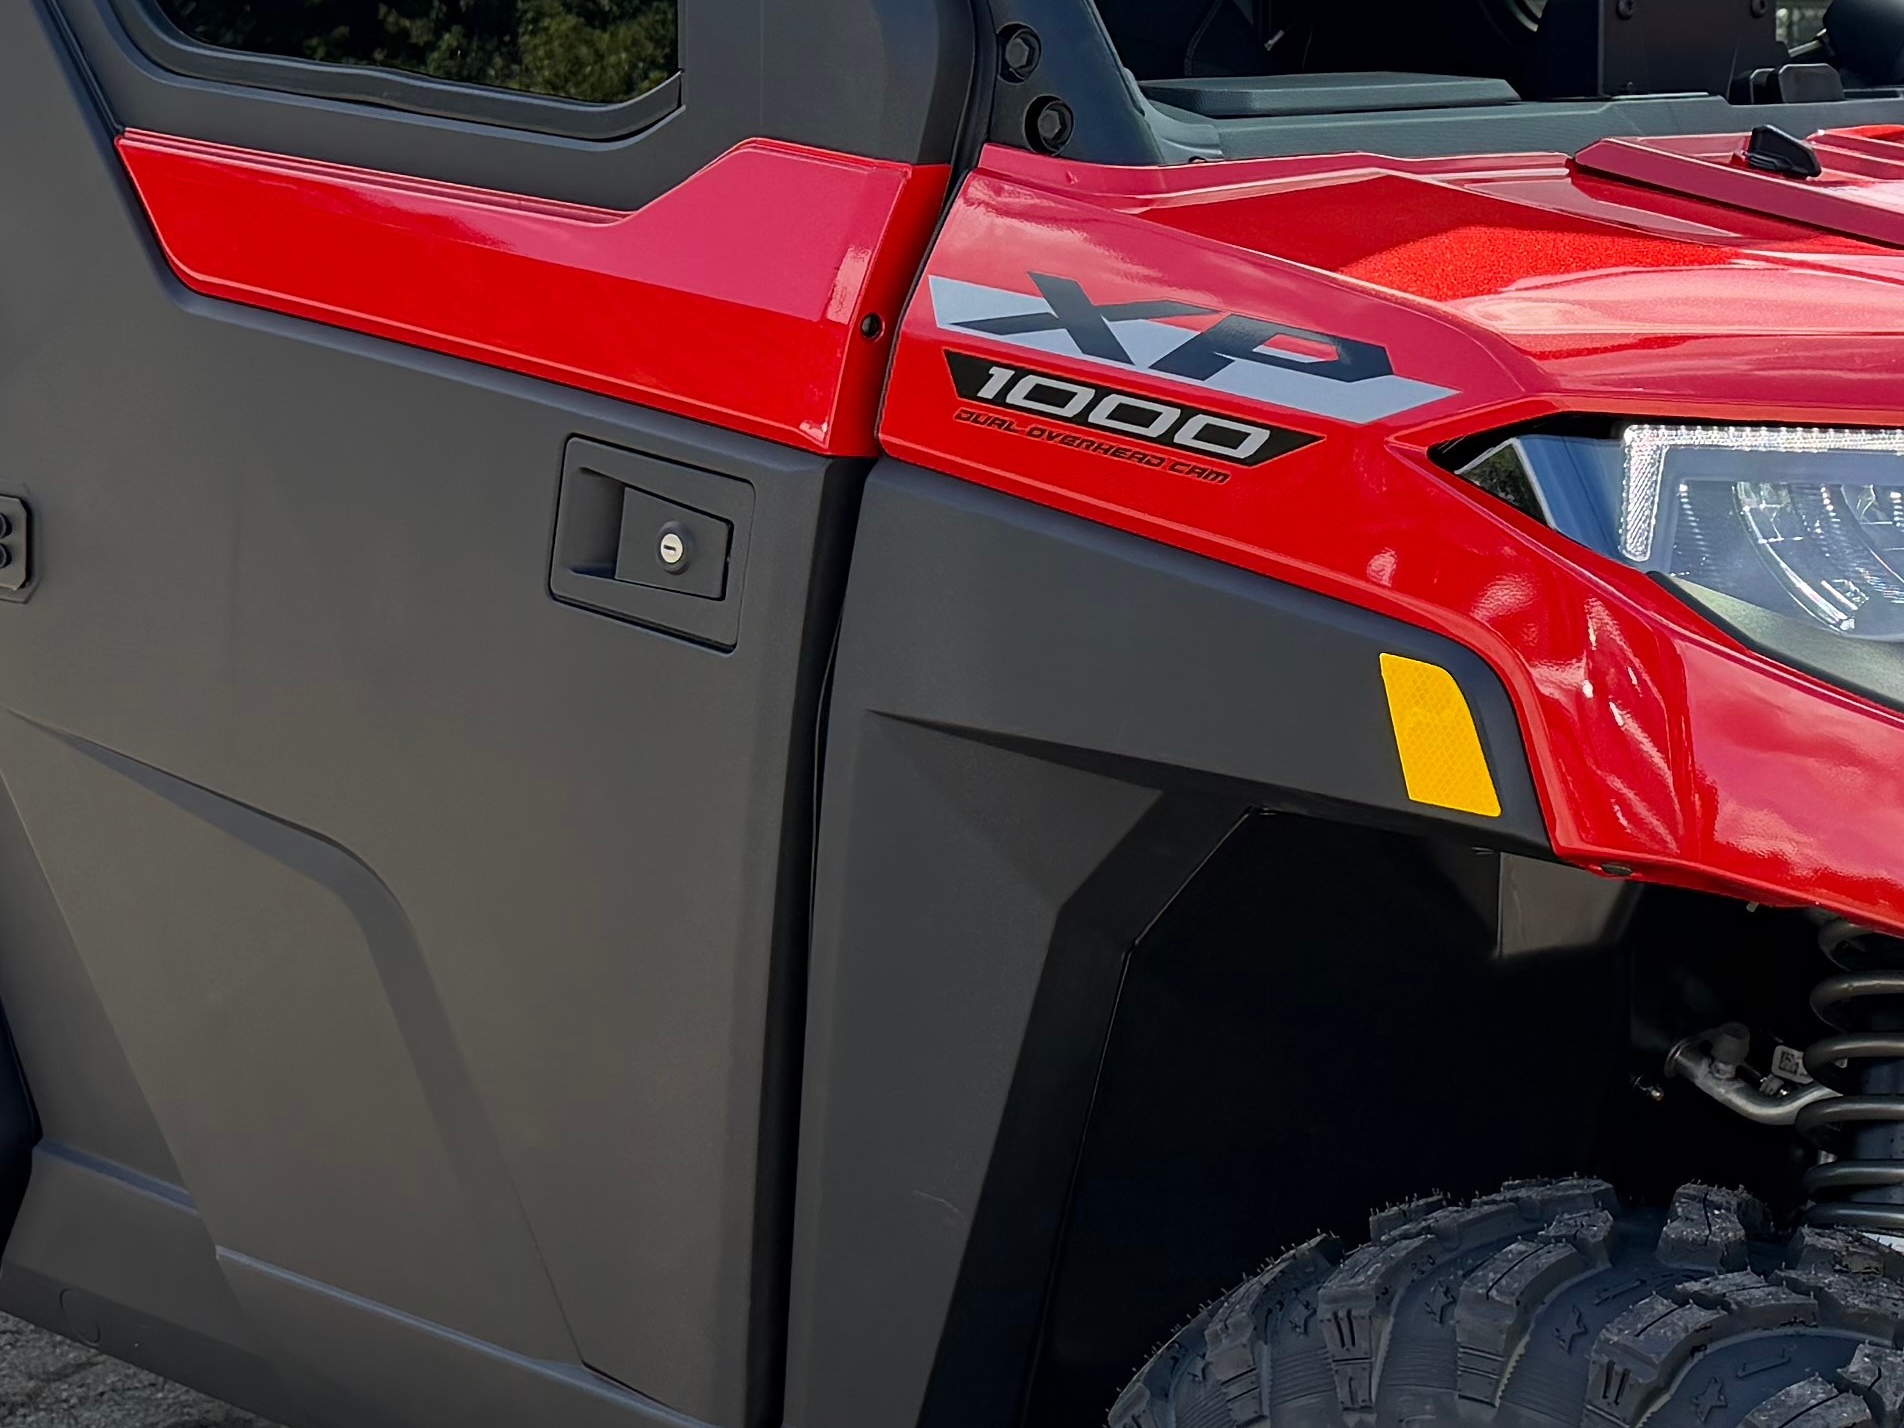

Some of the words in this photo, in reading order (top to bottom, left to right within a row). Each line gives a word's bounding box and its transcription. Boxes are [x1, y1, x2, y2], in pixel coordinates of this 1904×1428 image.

[947, 271, 1395, 383] XP
[953, 406, 1021, 434] DUAL
[1025, 425, 1166, 468] OVERHEAD
[1167, 459, 1231, 486] CAM
[975, 366, 1271, 460] 1000
